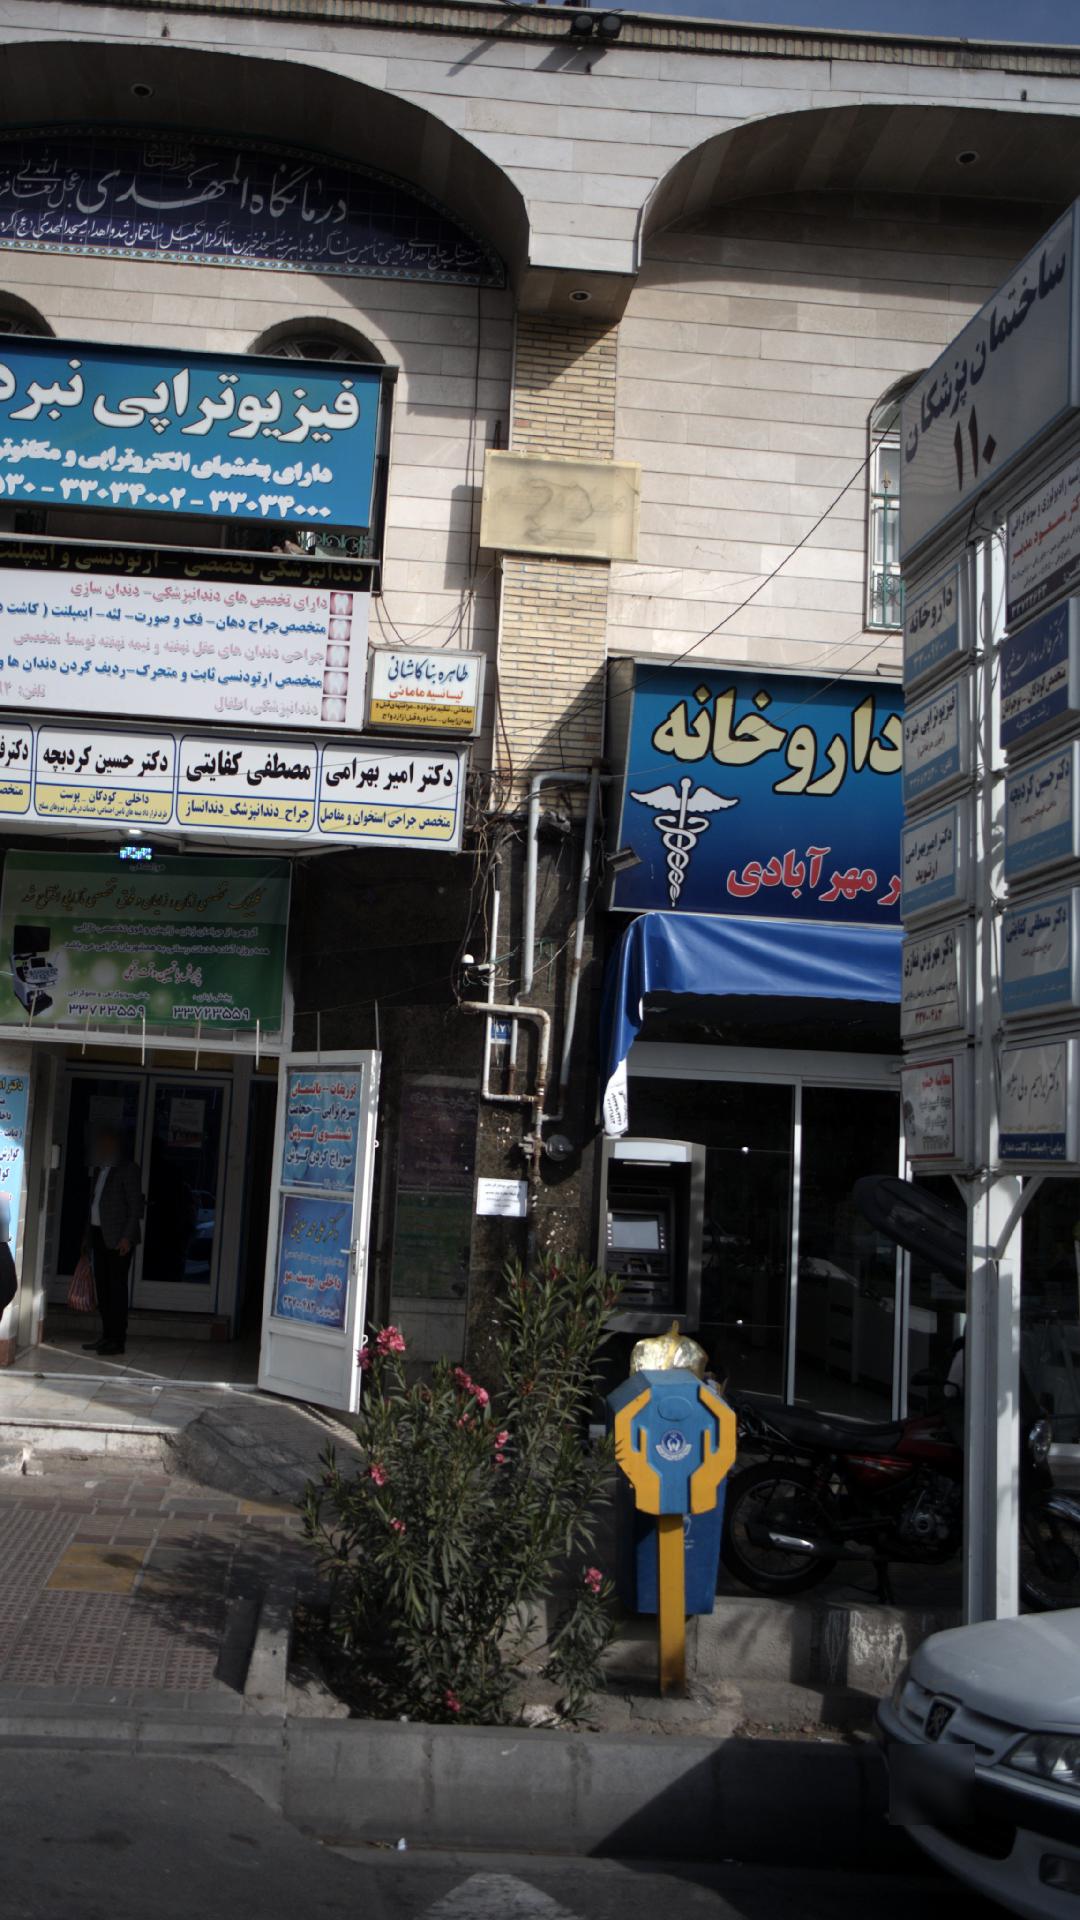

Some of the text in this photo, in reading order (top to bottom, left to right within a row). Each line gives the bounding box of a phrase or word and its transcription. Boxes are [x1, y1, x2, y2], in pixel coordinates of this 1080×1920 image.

[905, 248, 1067, 464] ساختمان پزشکان
[93, 367, 361, 444] فیزیوتراپی
[62, 449, 77, 468] و
[953, 404, 997, 492] ۱۱۰
[272, 461, 333, 489] دارای
[60, 477, 332, 518] ۳۳۰۳۴۰۰۲ ۳۳۰۳۴۰۰۰
[909, 585, 953, 634] داروخانه
[438, 662, 470, 685] طاهره
[652, 684, 903, 797] داروخانه
[95, 753, 135, 774] حسین
[137, 750, 168, 777] دکتر
[186, 750, 311, 786] مصطفی کفایتی
[325, 757, 453, 793] دکتر امیر بهرامی
